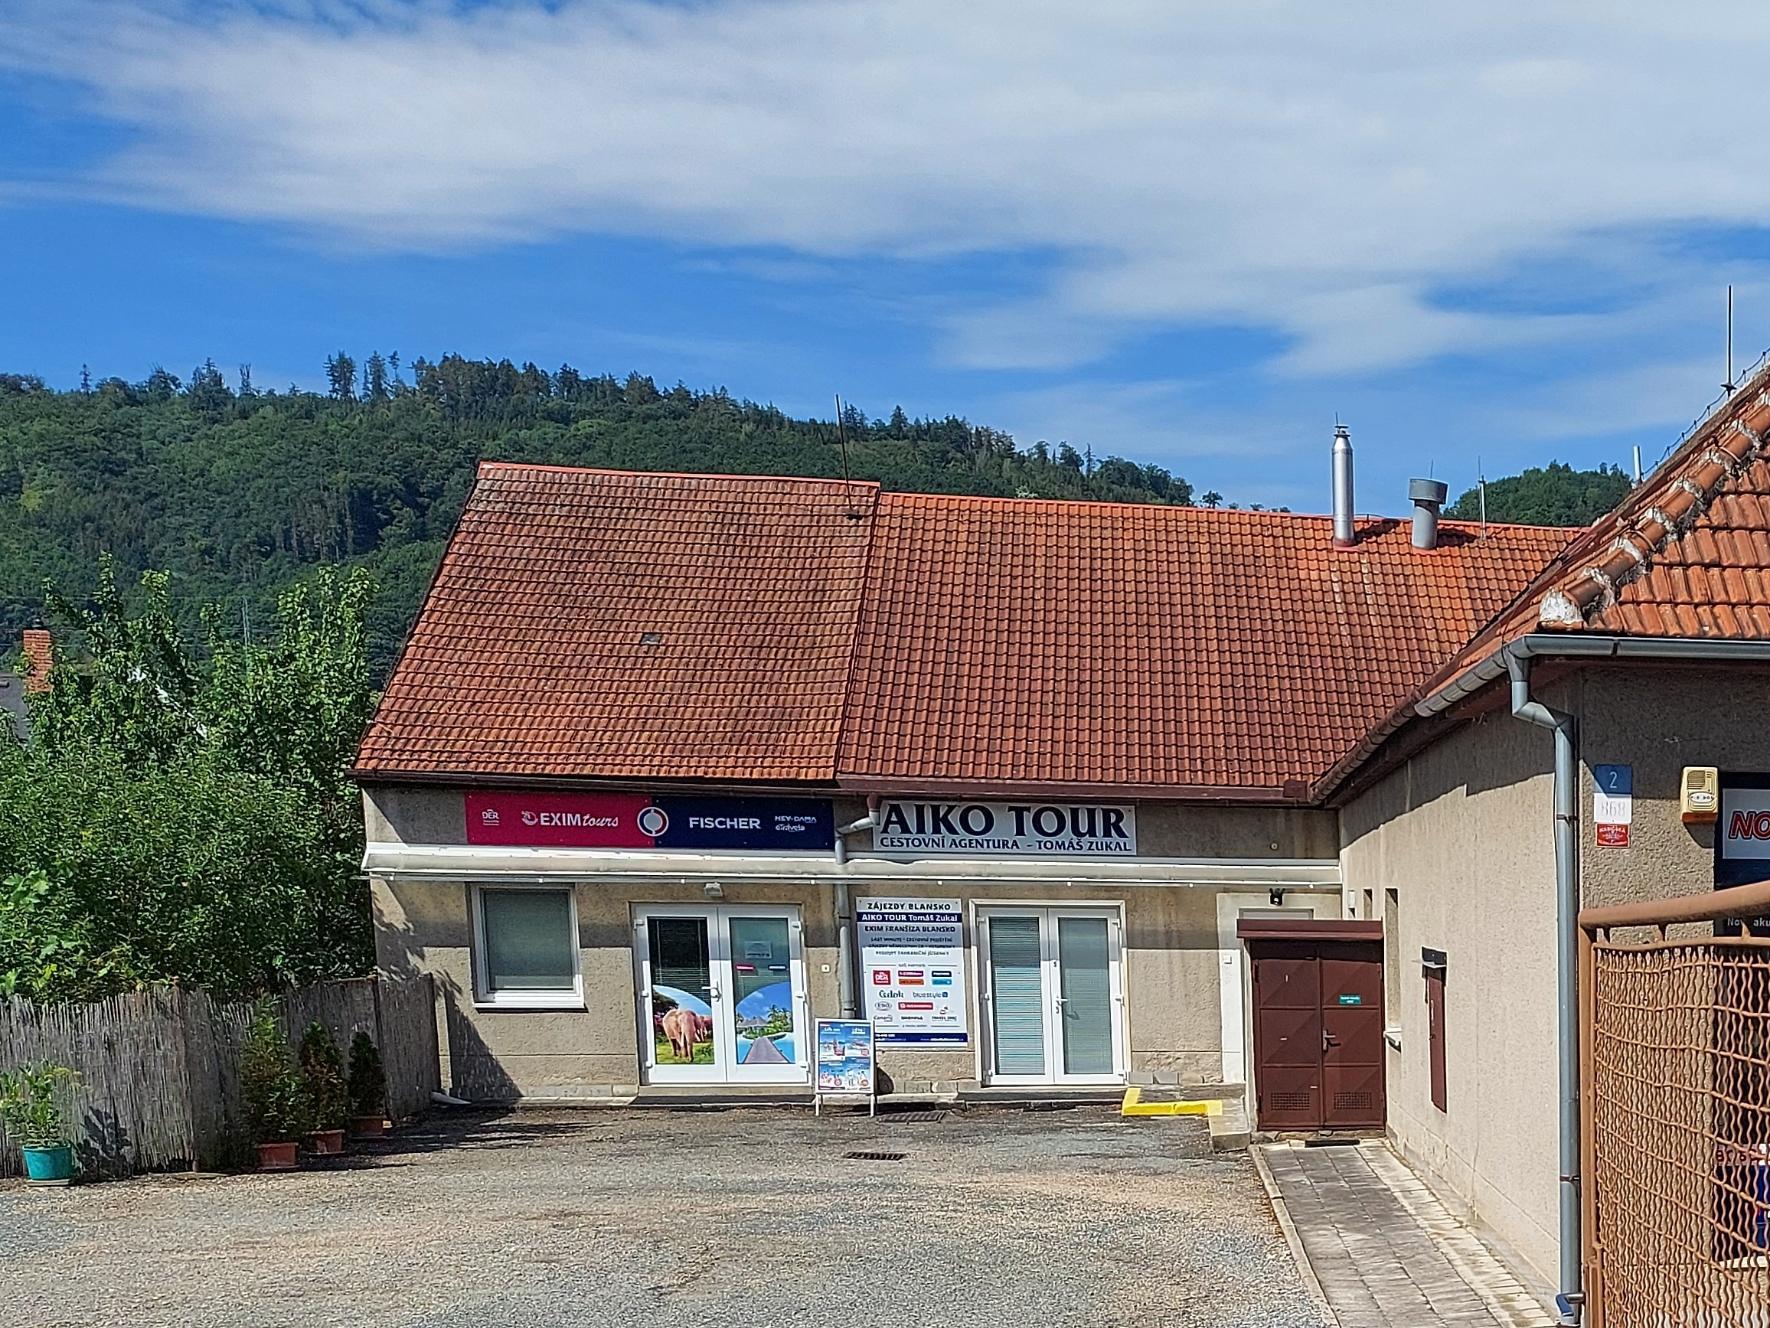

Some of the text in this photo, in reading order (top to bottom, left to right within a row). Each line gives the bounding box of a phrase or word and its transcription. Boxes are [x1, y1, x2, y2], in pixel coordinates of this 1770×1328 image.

[1609, 771, 1618, 789] 2
[689, 817, 761, 829] FISCHER
[880, 803, 1130, 838] AIKO TOUR
[880, 836, 946, 848] CESTOVNÍ
[949, 837, 1020, 849] AGENTURA
[1036, 836, 1083, 850] TOMÁŠ
[1087, 840, 1132, 851] ZUKAL
[867, 901, 951, 911] ZÁJEZDY BLANSKO
[936, 914, 957, 922] Zukal
